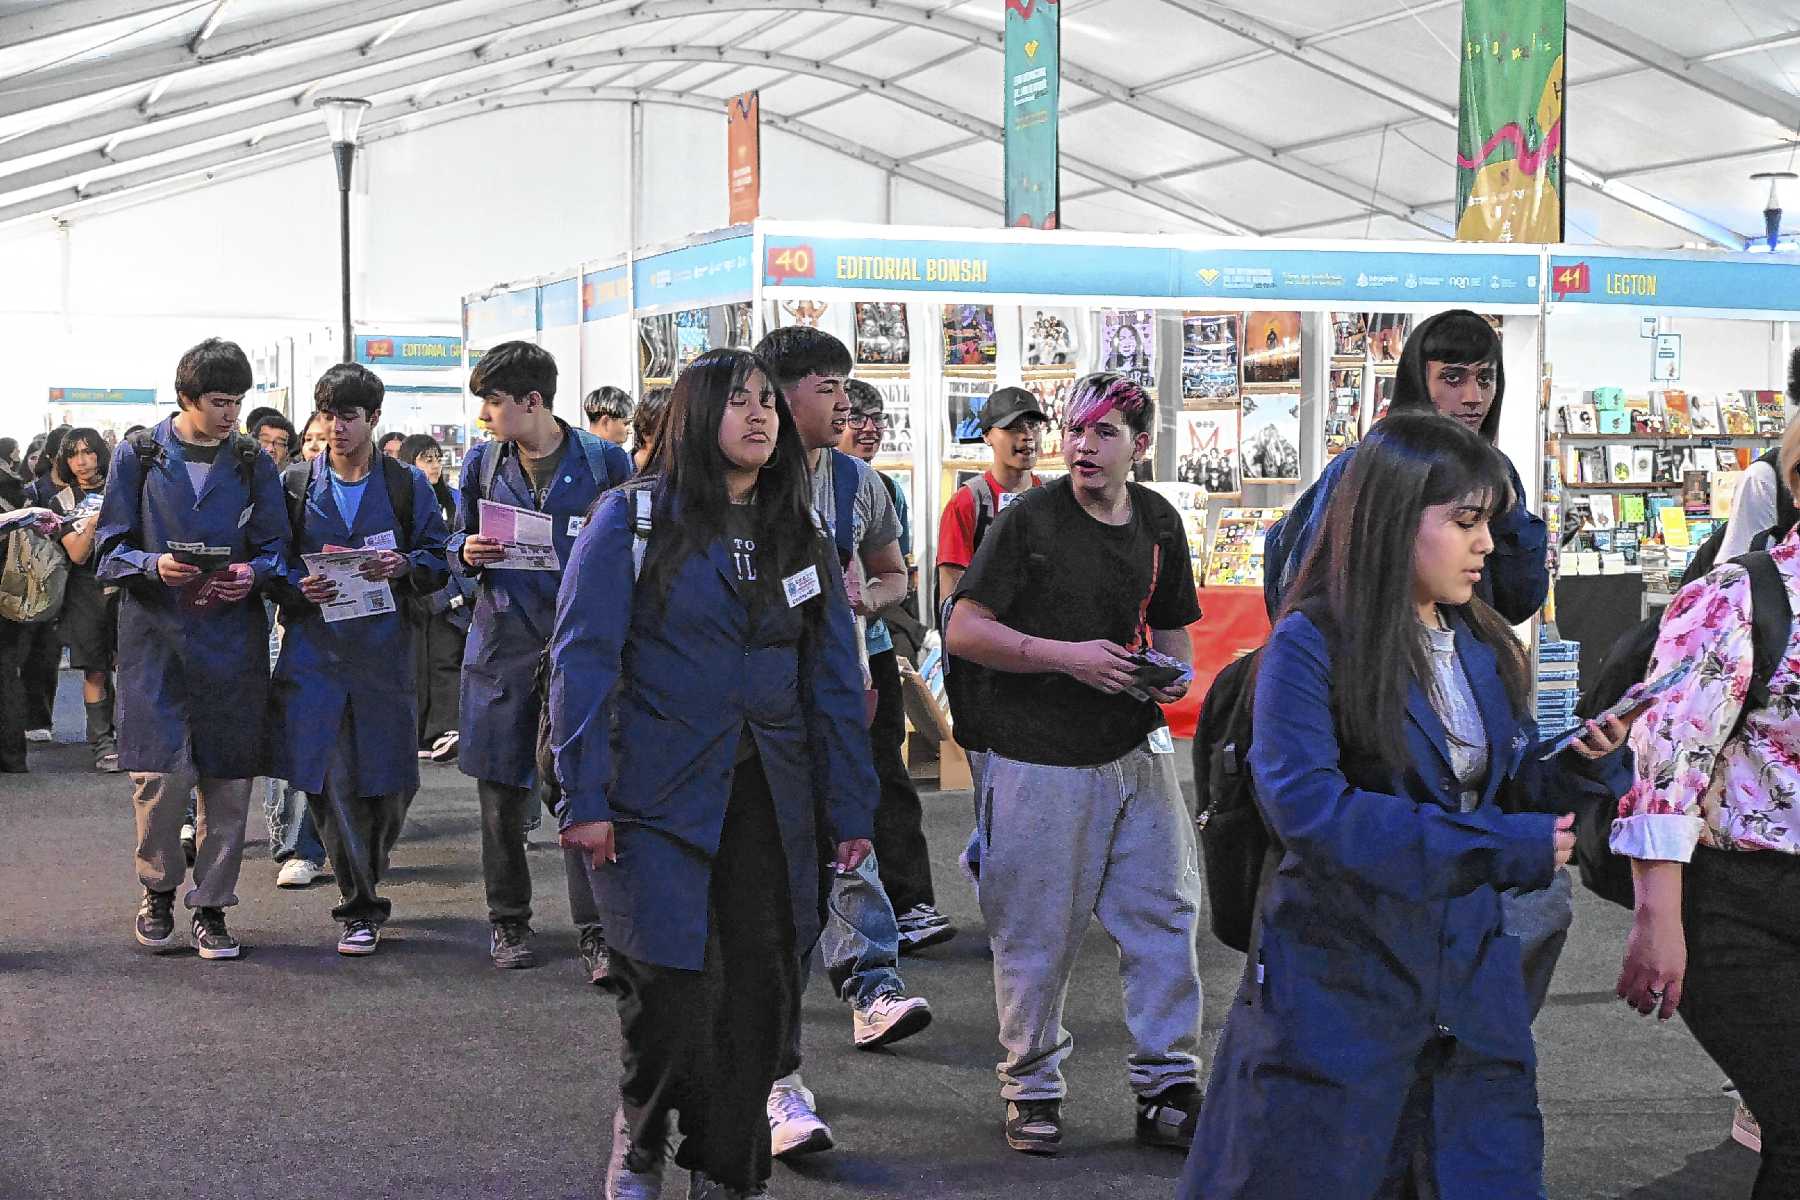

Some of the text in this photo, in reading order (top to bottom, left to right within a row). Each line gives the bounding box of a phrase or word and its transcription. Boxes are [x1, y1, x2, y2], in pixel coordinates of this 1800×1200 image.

[775, 251, 808, 272] 40
[836, 256, 988, 282] EDITORIAL BONSAI
[1558, 268, 1582, 289] 41
[1606, 273, 1657, 296] LECTON
[402, 343, 448, 358] EDITORIAL
